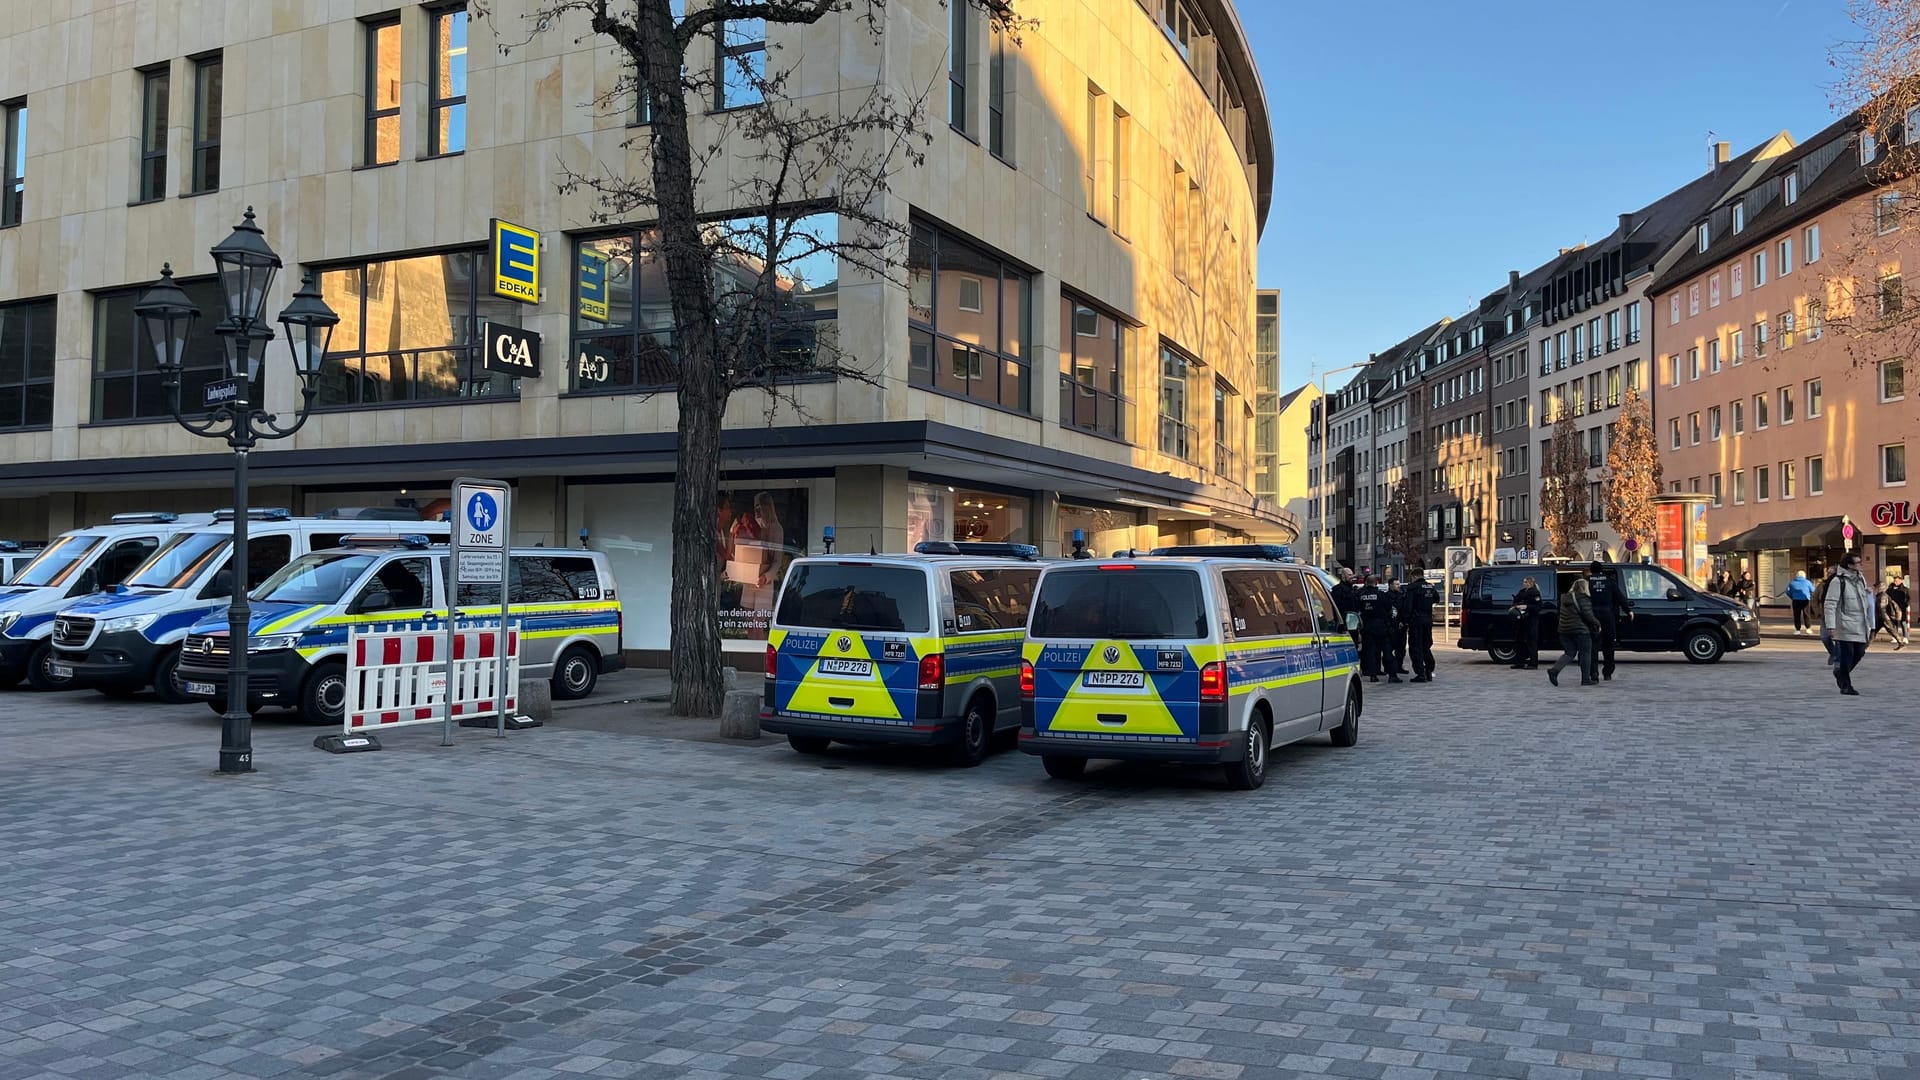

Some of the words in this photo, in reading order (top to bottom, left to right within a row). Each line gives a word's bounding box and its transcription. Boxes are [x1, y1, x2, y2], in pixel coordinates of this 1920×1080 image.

[499, 280, 535, 298] EDEKA
[496, 333, 534, 368] C&A
[207, 383, 237, 401] Ludwigsplatz
[1871, 502, 1920, 527] GL
[470, 533, 493, 544] ZONE
[586, 587, 598, 598] 110
[730, 608, 755, 617] deiner
[724, 619, 736, 628] ein
[737, 620, 768, 629] zweites
[786, 638, 818, 650] POLIZEI
[1044, 652, 1081, 663] POLIZEI
[826, 662, 833, 671] N
[838, 662, 850, 671] PP
[850, 663, 867, 673] 278
[1092, 673, 1099, 684] N
[1105, 674, 1118, 685] PP
[1120, 674, 1139, 685] 276
[239, 754, 250, 762] 45
